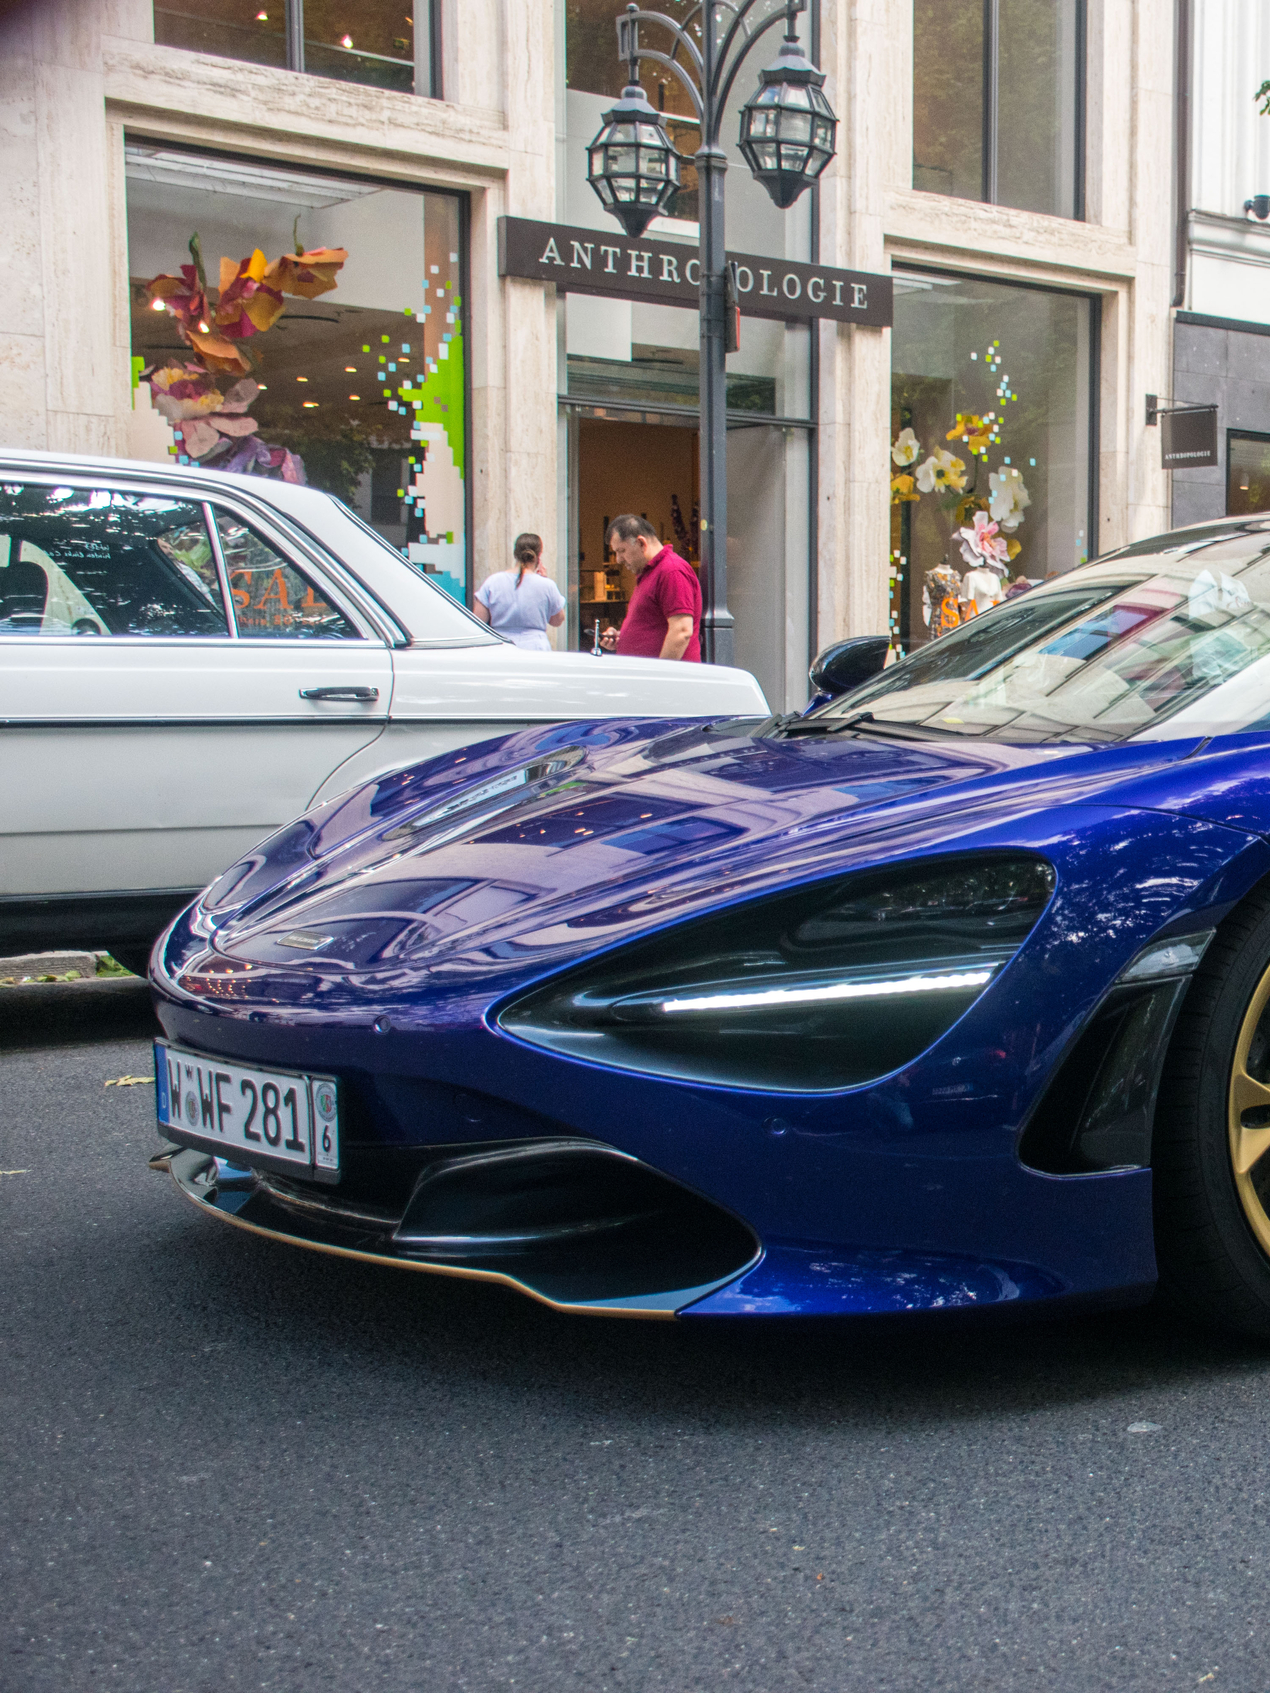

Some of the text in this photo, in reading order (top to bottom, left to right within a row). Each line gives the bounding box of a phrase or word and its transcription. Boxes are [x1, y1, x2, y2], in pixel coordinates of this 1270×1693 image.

[539, 237, 867, 309] ANTHROOLOGIE
[168, 1056, 182, 1119] W
[197, 1064, 232, 1133] WF
[240, 1077, 306, 1153] 281
[322, 1124, 332, 1153] 6
